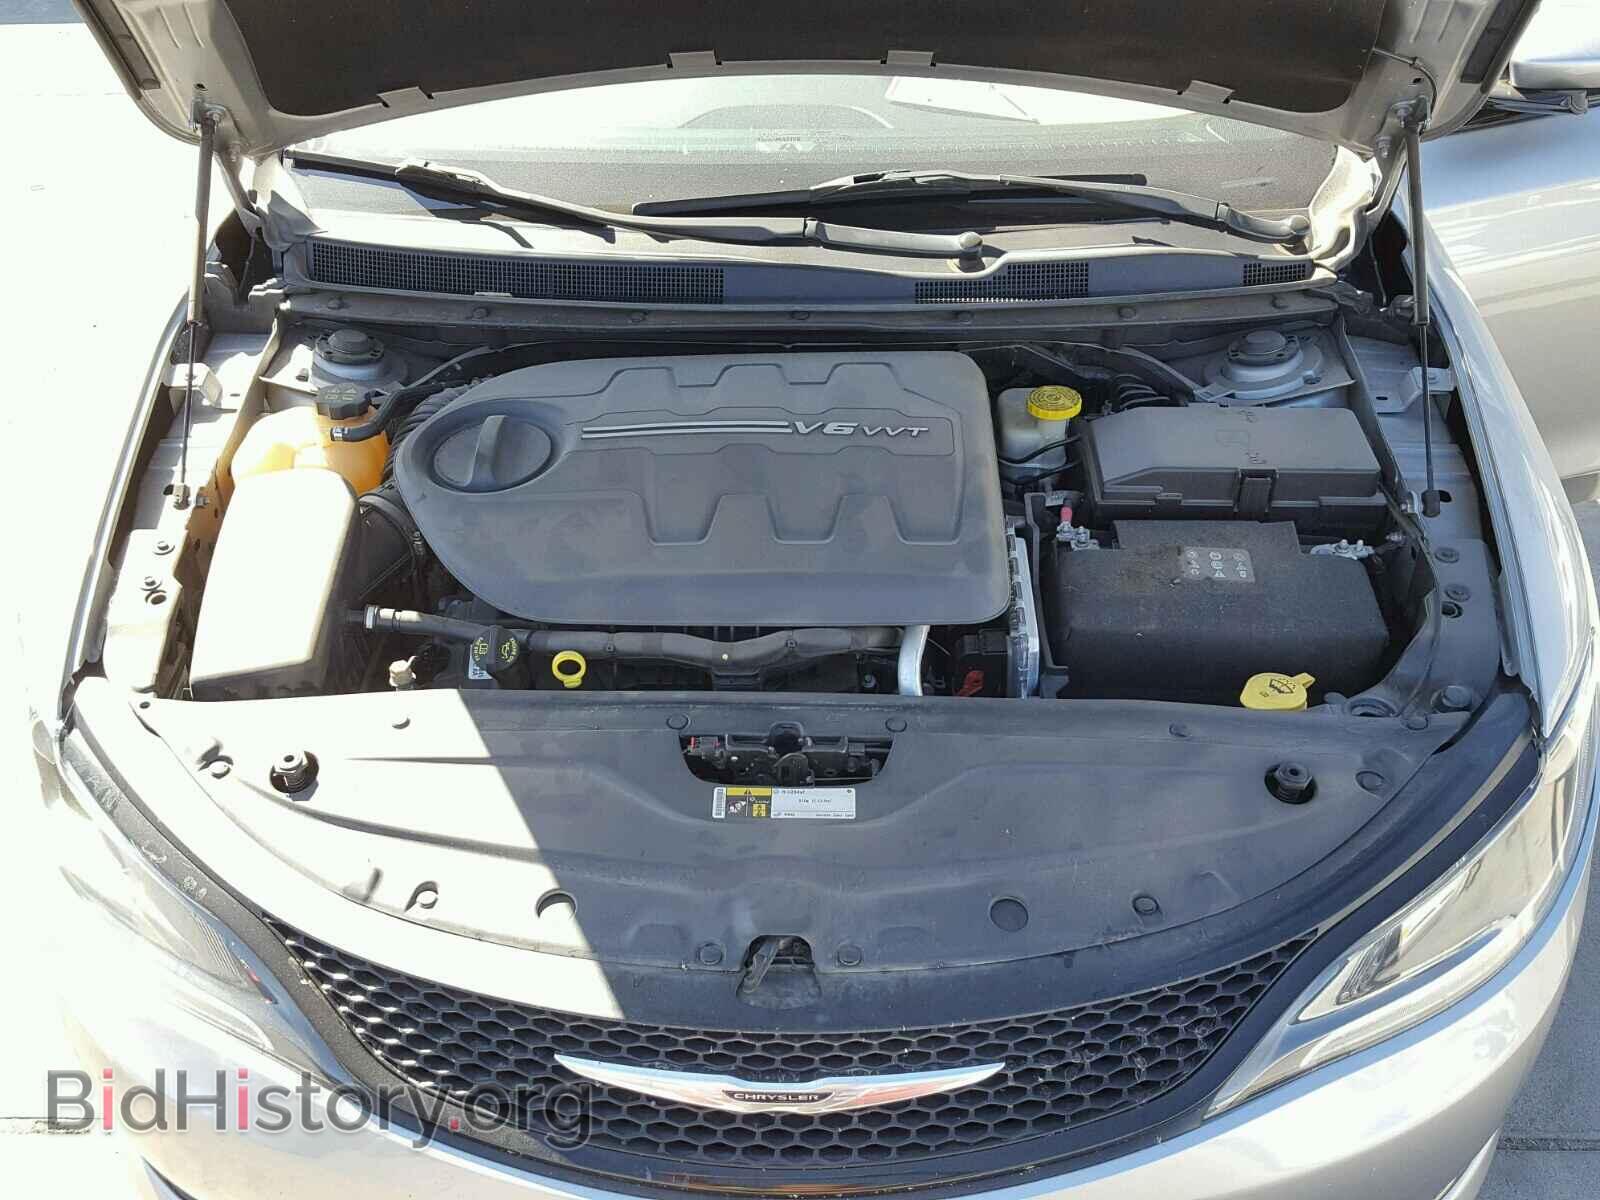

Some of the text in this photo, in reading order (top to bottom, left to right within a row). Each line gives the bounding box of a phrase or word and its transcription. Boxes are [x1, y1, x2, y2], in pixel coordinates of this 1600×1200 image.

[795, 421, 928, 437] V6 VVT
[733, 1092, 819, 1101] CHRYSLER
